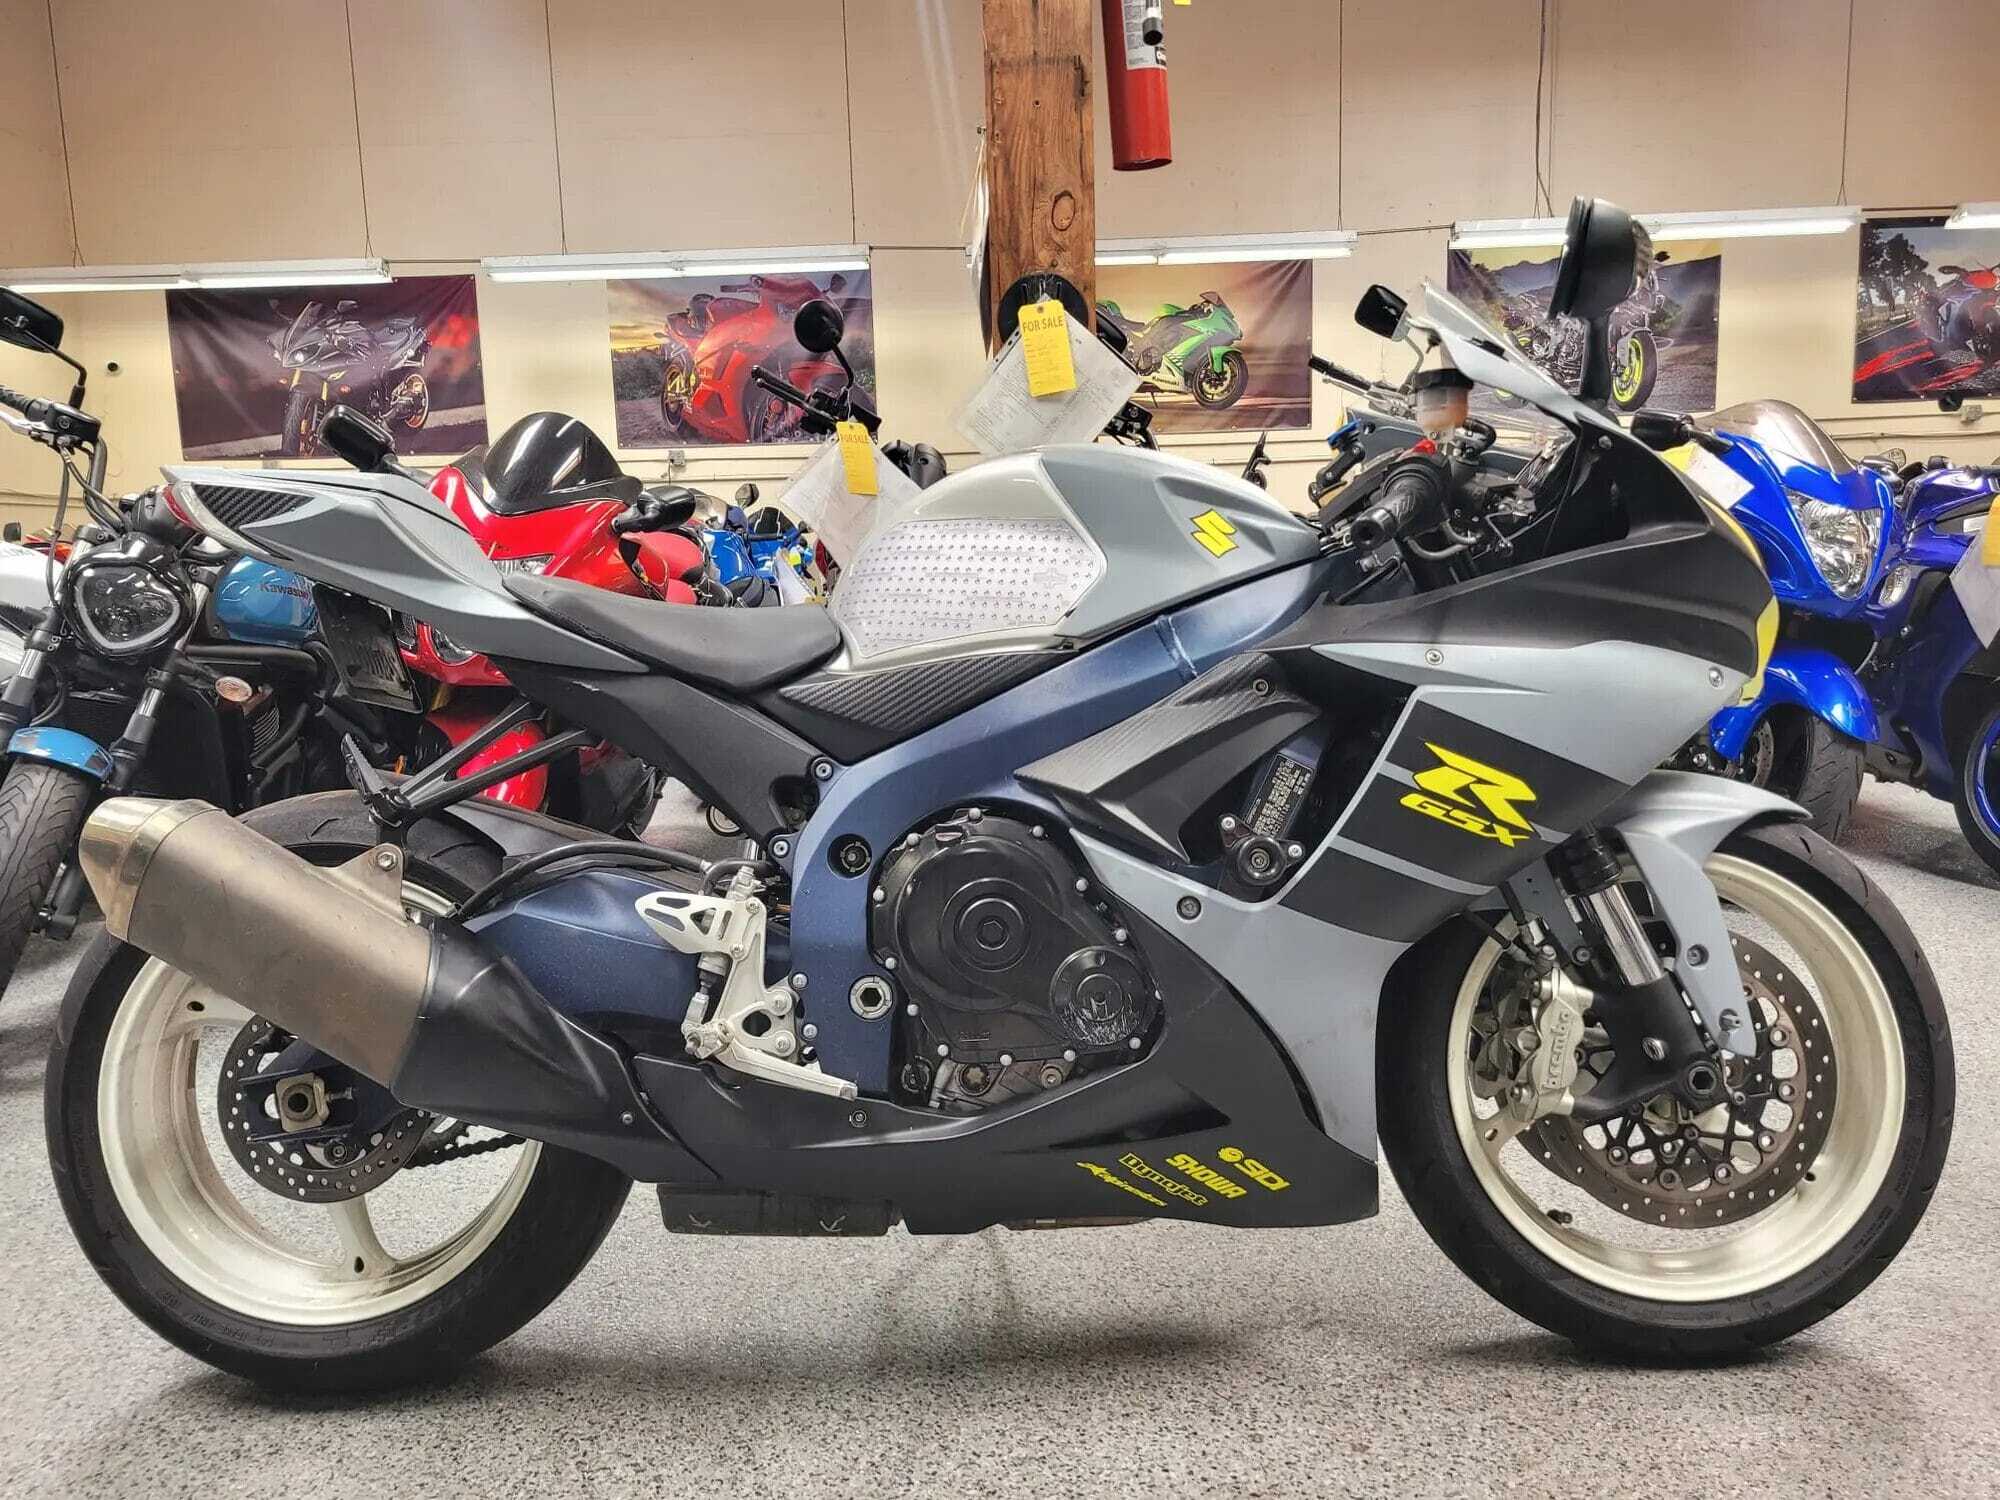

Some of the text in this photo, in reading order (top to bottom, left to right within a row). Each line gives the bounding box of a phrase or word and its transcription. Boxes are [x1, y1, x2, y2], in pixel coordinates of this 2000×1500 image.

[1023, 315, 1065, 332] FOR SALE
[260, 583, 309, 599] Kawas
[1543, 1009, 1571, 1090] brembo
[1118, 1152, 1208, 1206] Dynojet
[1165, 1153, 1248, 1199] SHOWA
